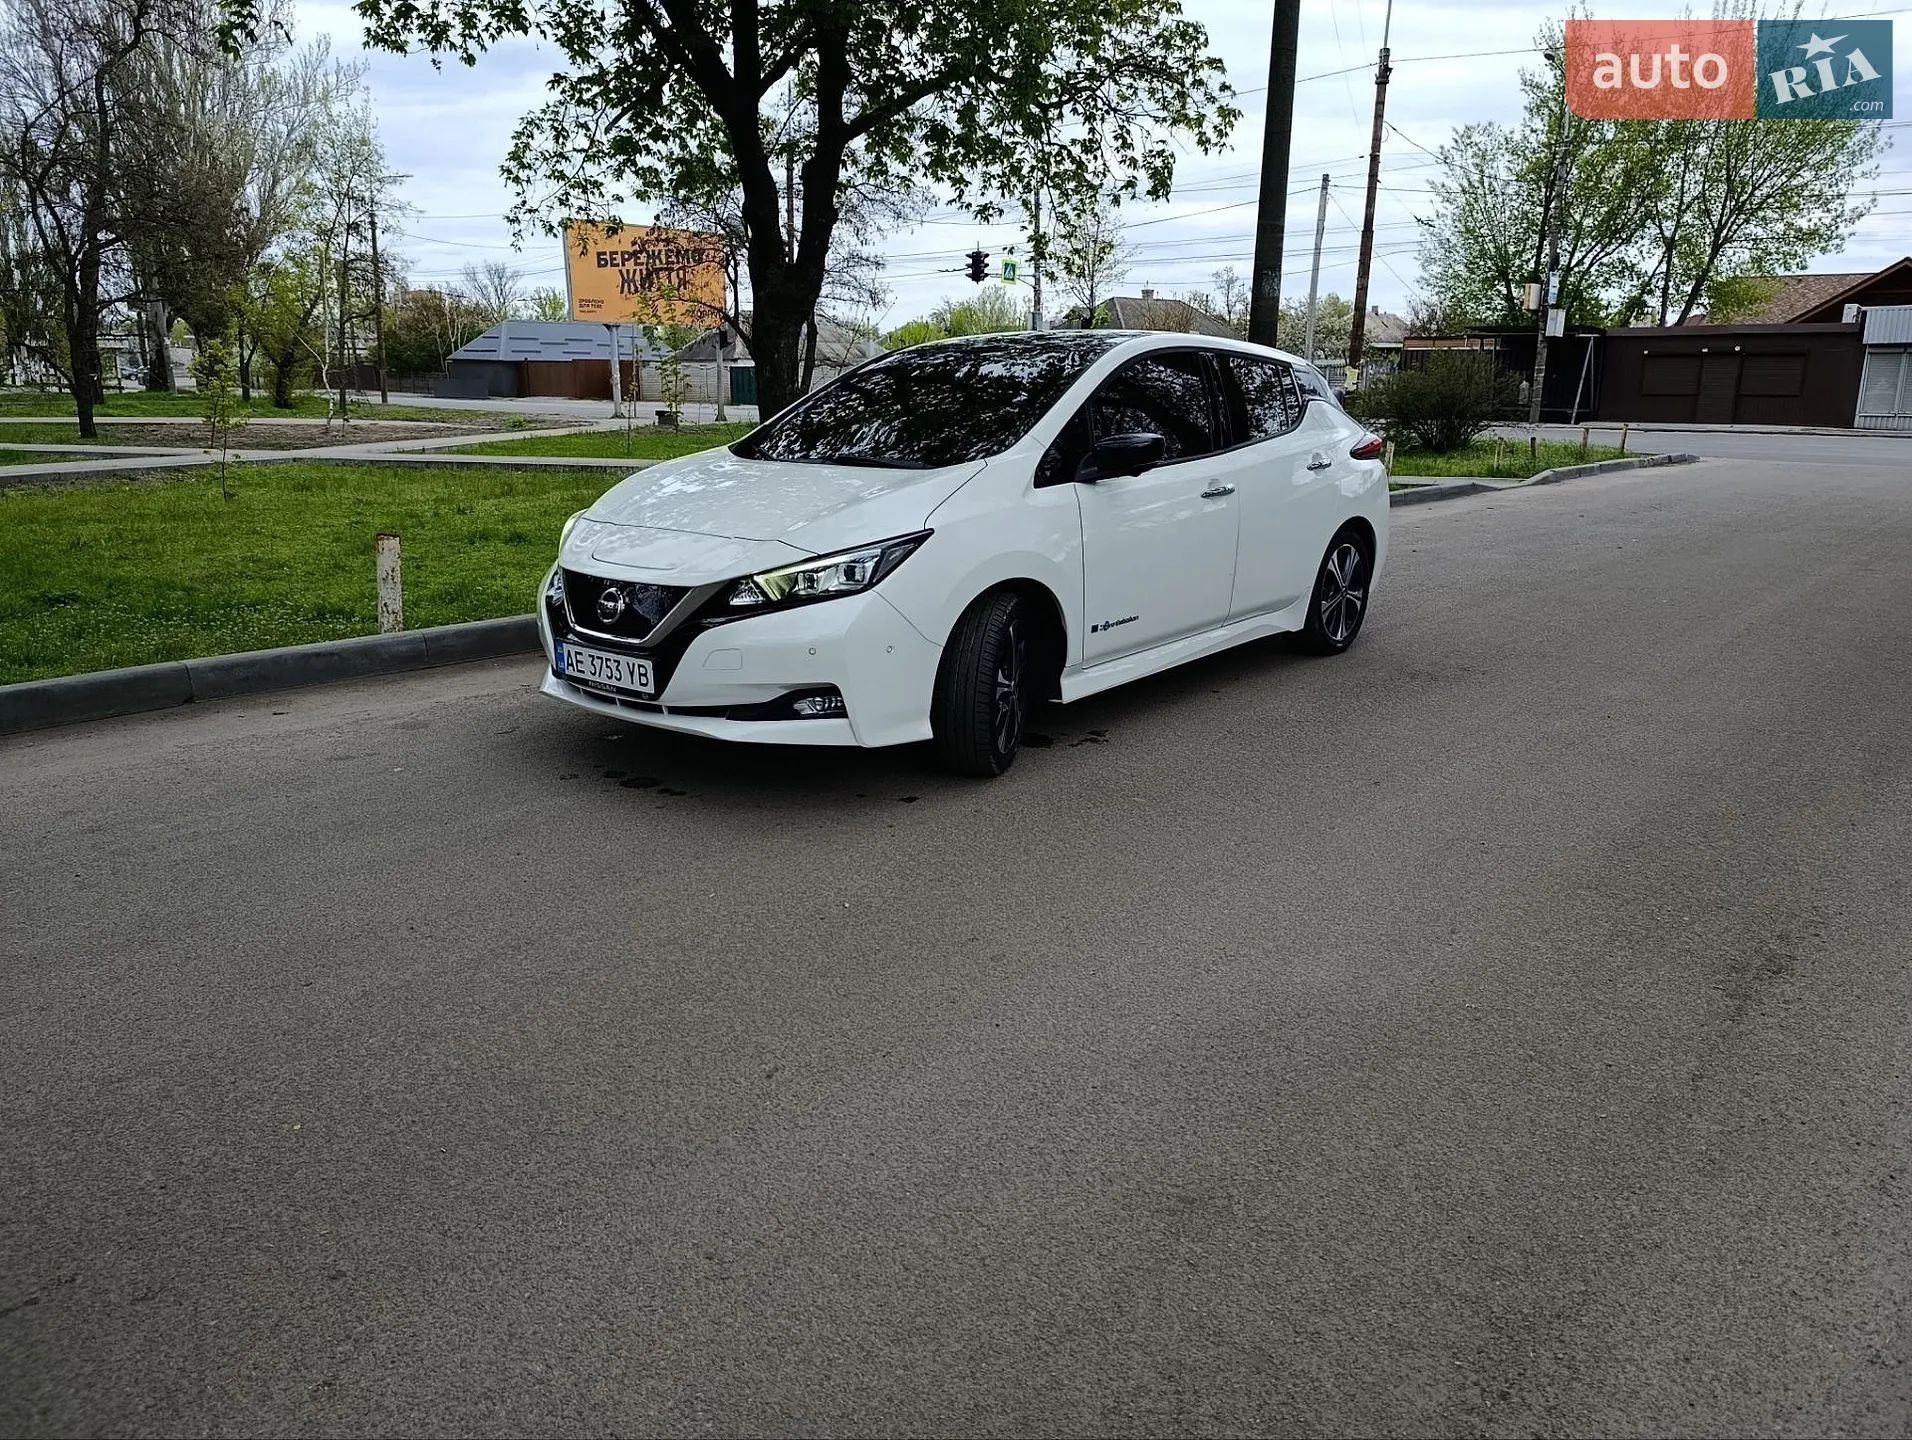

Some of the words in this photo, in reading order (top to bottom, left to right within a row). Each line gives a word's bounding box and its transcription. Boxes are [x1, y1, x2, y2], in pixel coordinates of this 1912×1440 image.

[566, 649, 585, 674] AE
[588, 653, 622, 681] 3753
[626, 661, 649, 687] YB
